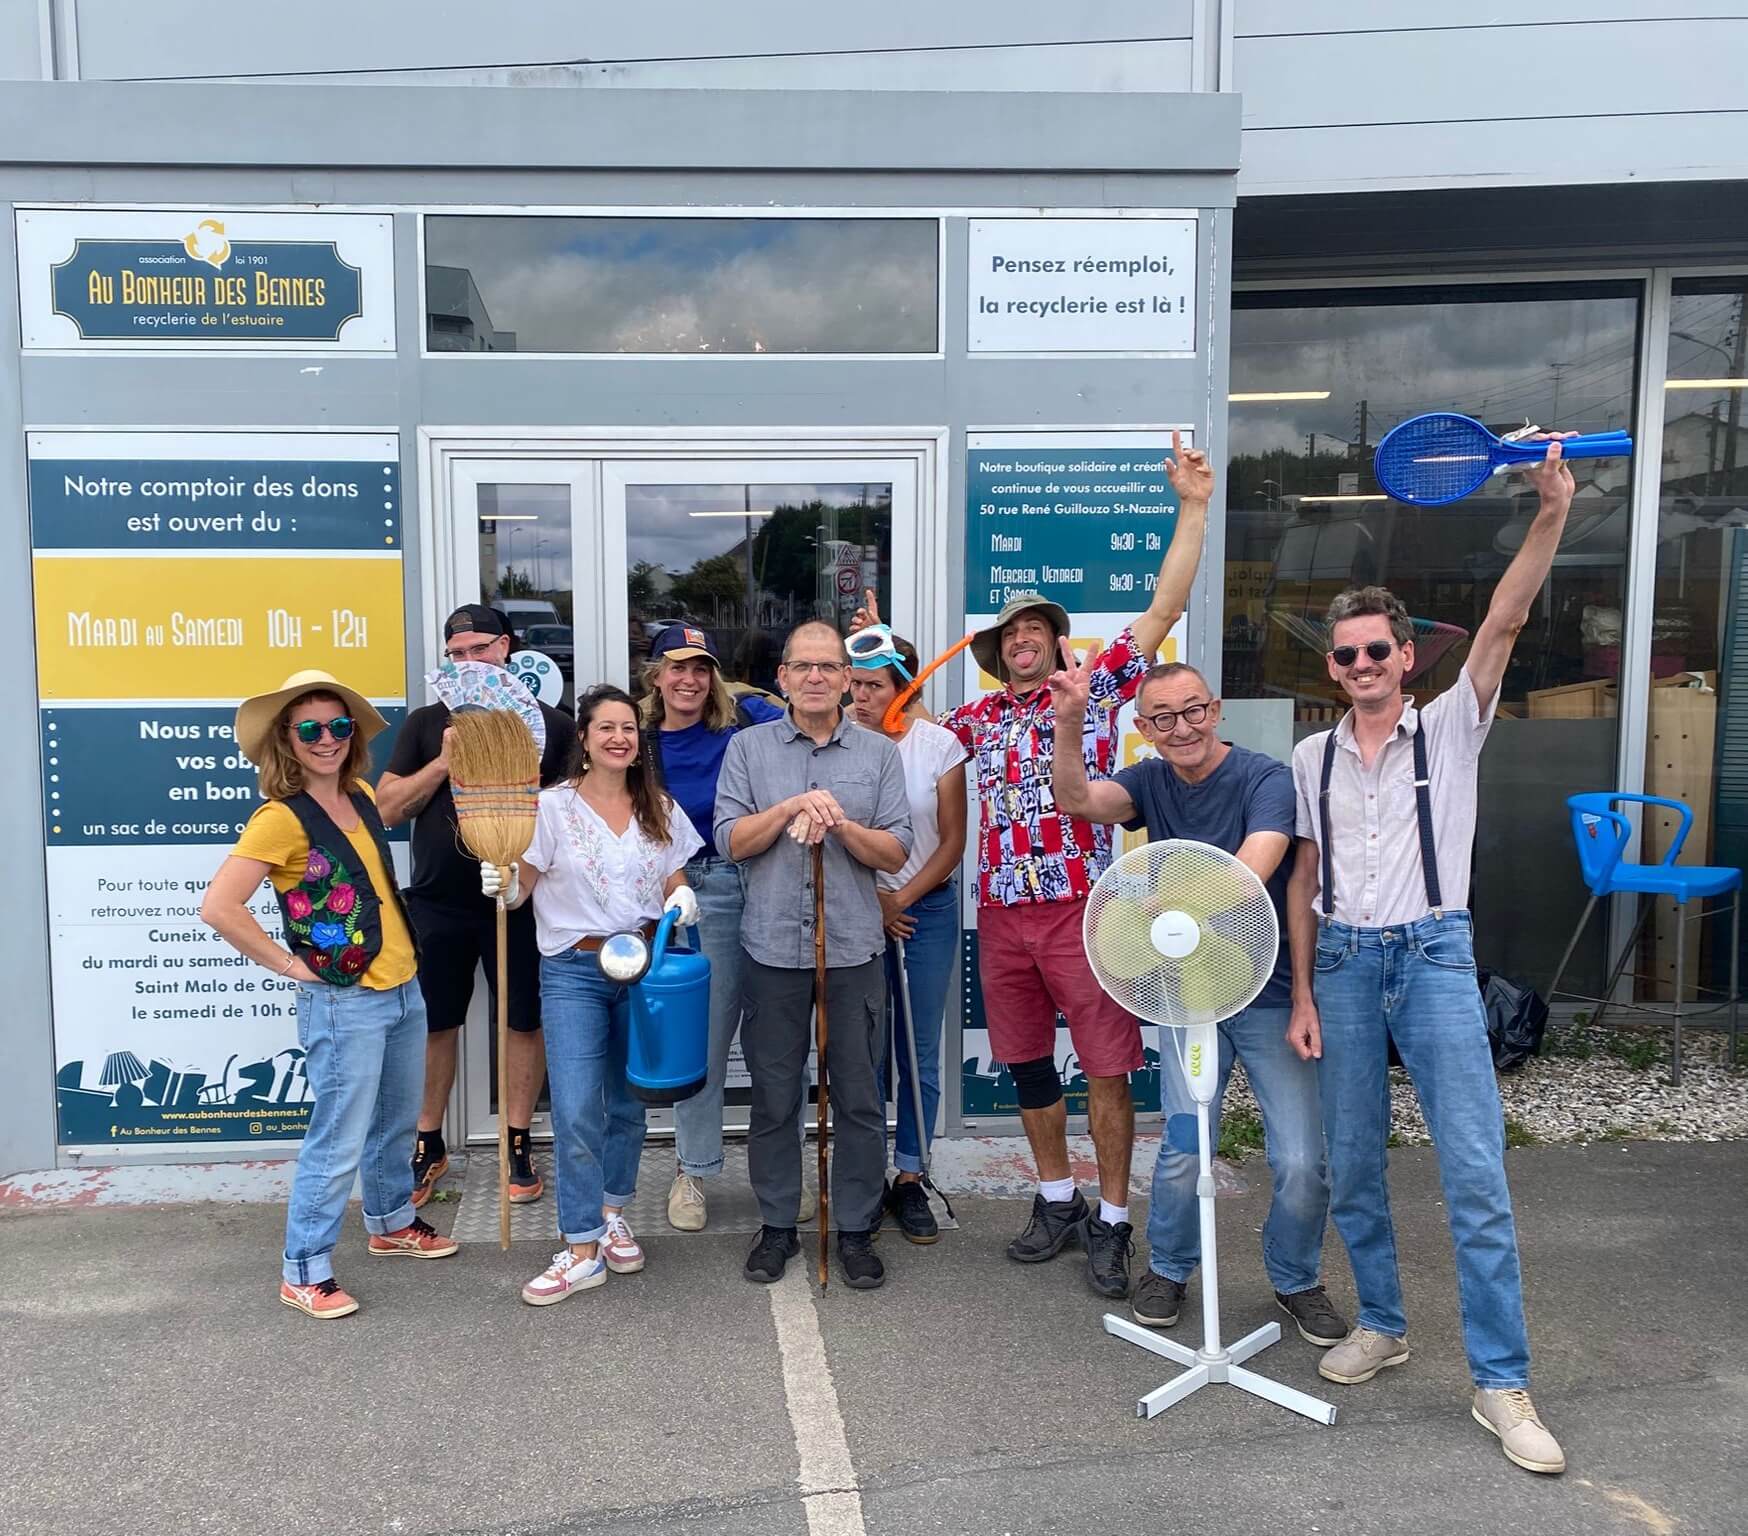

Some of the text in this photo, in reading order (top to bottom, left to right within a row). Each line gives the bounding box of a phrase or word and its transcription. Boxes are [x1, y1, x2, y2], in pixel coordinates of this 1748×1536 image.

[138, 255, 187, 265] association
[234, 256, 269, 265] loi 1901
[991, 255, 1175, 277] Pensez réemploi,
[979, 295, 999, 314] la
[1007, 295, 1108, 317] recyclerie
[1115, 296, 1146, 314] est
[1152, 296, 1172, 314] là
[132, 312, 284, 327] recyclerie de l'estuaire
[980, 461, 1167, 475] Notre boutique solidaire et créati
[63, 475, 359, 501] Notre comptoir des dons
[991, 482, 1165, 495] continue de vous accueillir au
[979, 503, 1175, 515] 50 rue René Guillouzo St-Nazaire
[127, 513, 161, 533] est
[168, 513, 244, 532] ouvert
[252, 511, 282, 532] du
[140, 721, 201, 740] Nous
[176, 755, 217, 770] vos
[168, 786, 198, 801] en
[205, 781, 251, 800] bon
[83, 823, 105, 836] un
[110, 823, 140, 835] sac
[145, 820, 167, 835] de
[172, 822, 230, 835] course
[98, 879, 134, 892] Pour
[138, 879, 179, 891] toute
[91, 904, 162, 918] retrouvez
[166, 905, 202, 916] nous
[148, 929, 207, 943] Cuneix
[82, 953, 249, 969] du mardi au samedi
[135, 978, 297, 994] Saint Malo de Gue
[131, 1006, 148, 1020] le
[152, 1005, 217, 1019] samedi
[222, 1004, 244, 1019] de
[251, 1004, 282, 1018] 10h
[161, 1108, 309, 1120] www.aubonheurdesbennes.fr
[120, 1127, 133, 1136] Au
[134, 1126, 170, 1136] Bonheur
[173, 1126, 188, 1135] des
[190, 1126, 222, 1135] Bennes
[266, 1122, 309, 1133] au_bonhe
